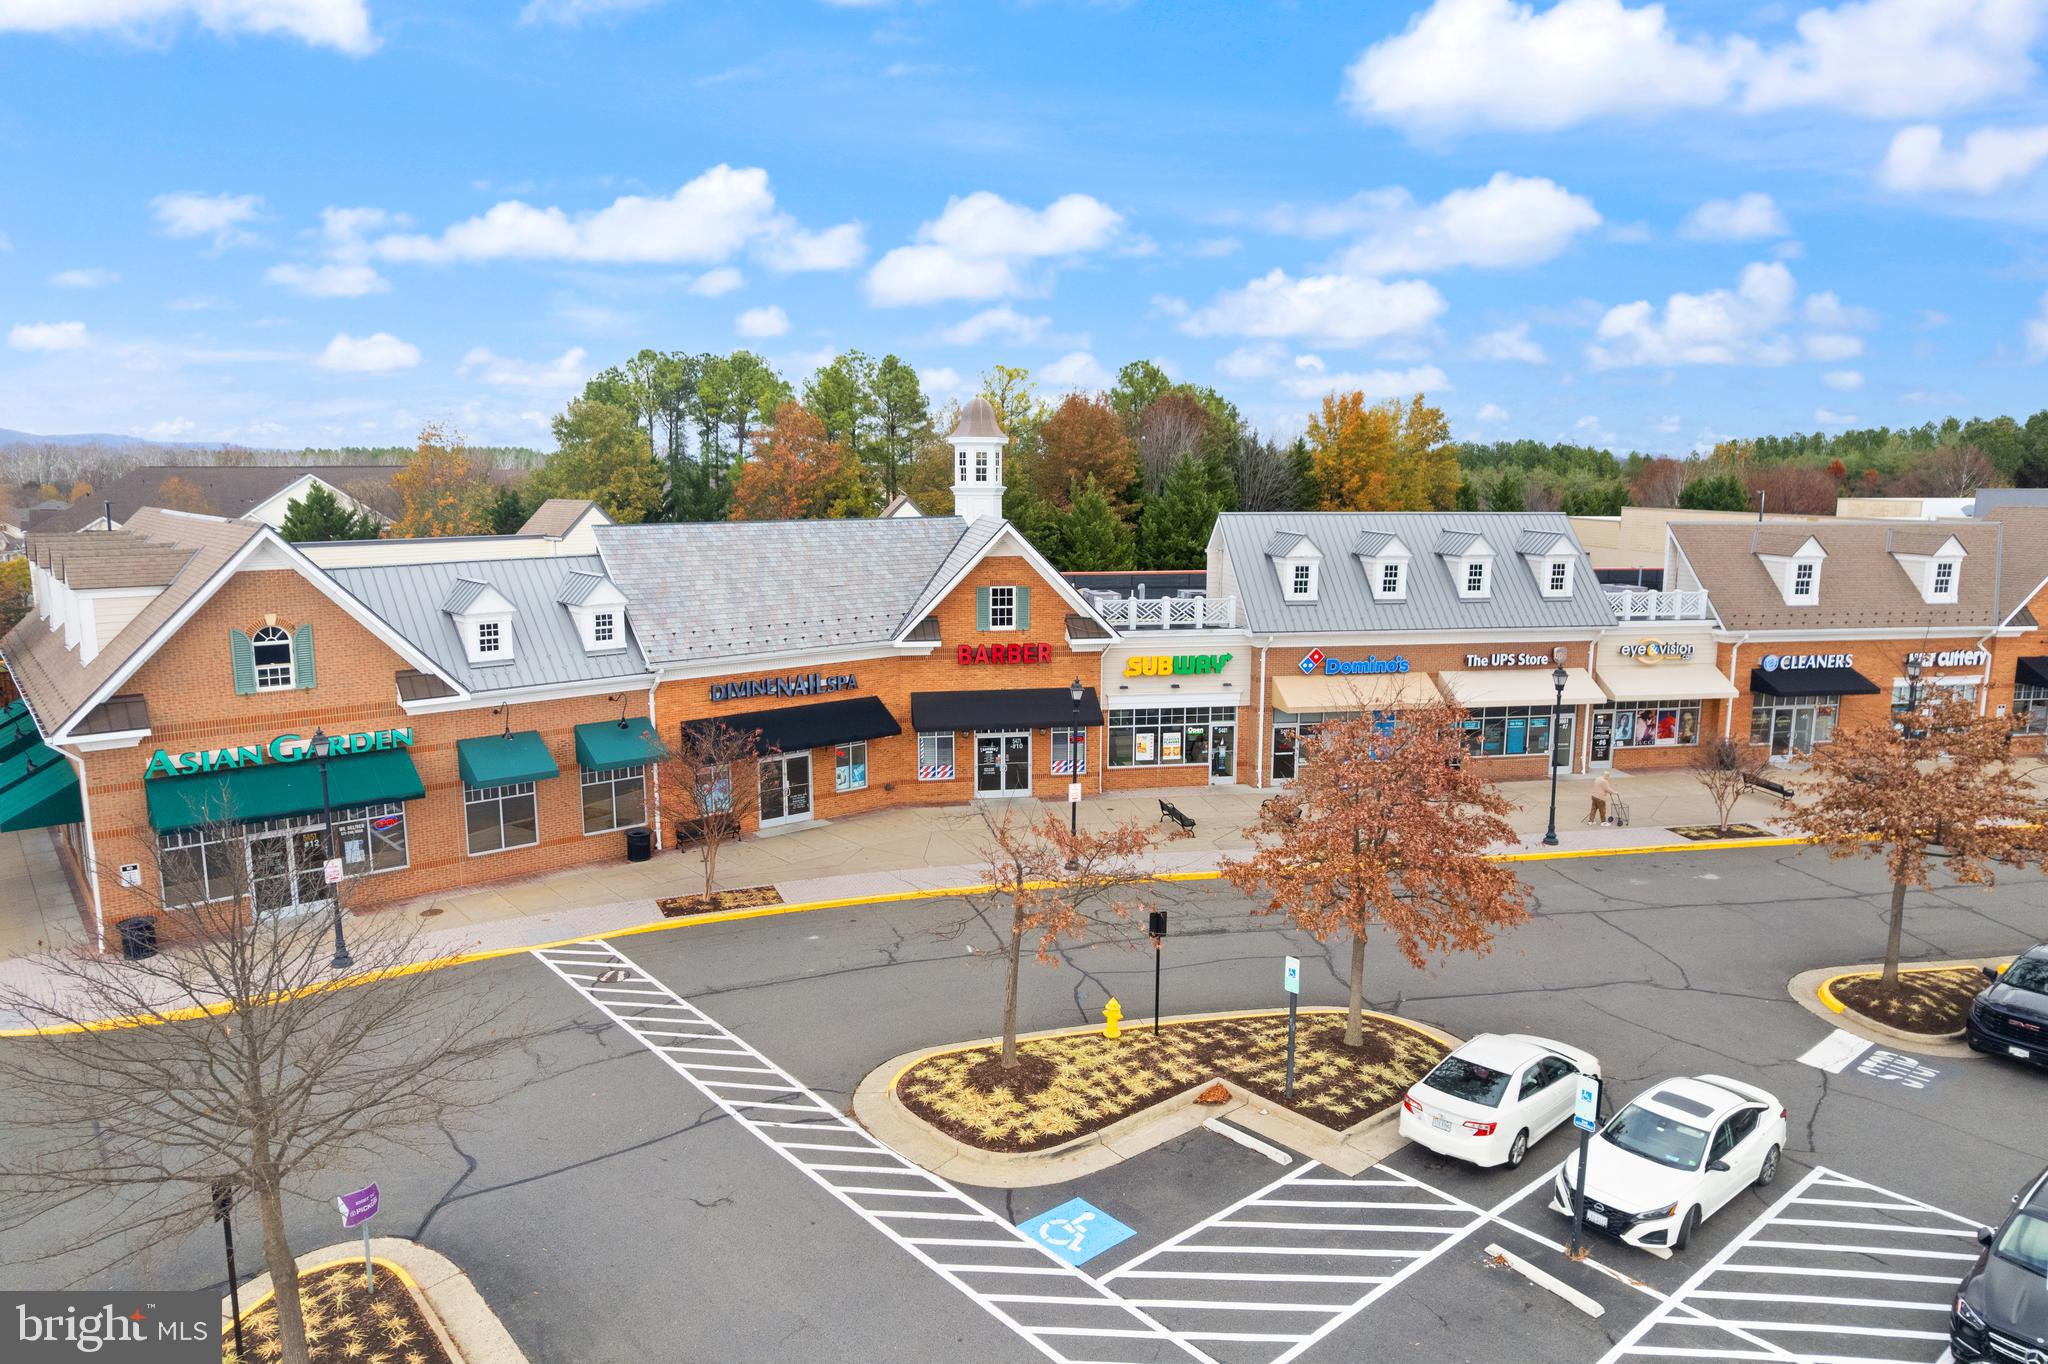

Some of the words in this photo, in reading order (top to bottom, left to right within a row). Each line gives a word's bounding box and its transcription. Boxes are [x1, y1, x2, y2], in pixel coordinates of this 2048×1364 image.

[958, 642, 1052, 665] BARBER
[1466, 654, 1488, 667] The
[1491, 653, 1515, 666] UPS
[1518, 653, 1548, 666] Store
[1620, 644, 1646, 657] eye
[1660, 642, 1695, 655] vision
[1123, 653, 1233, 677] SUBWAY
[1325, 655, 1409, 675] Domino's
[1780, 653, 1853, 670] CLEANERS
[711, 677, 773, 701] DIVINE
[776, 673, 826, 698] NAIL
[825, 674, 858, 692] SPA
[144, 745, 262, 779] ASIAN
[1857, 1050, 1941, 1089] STOP
